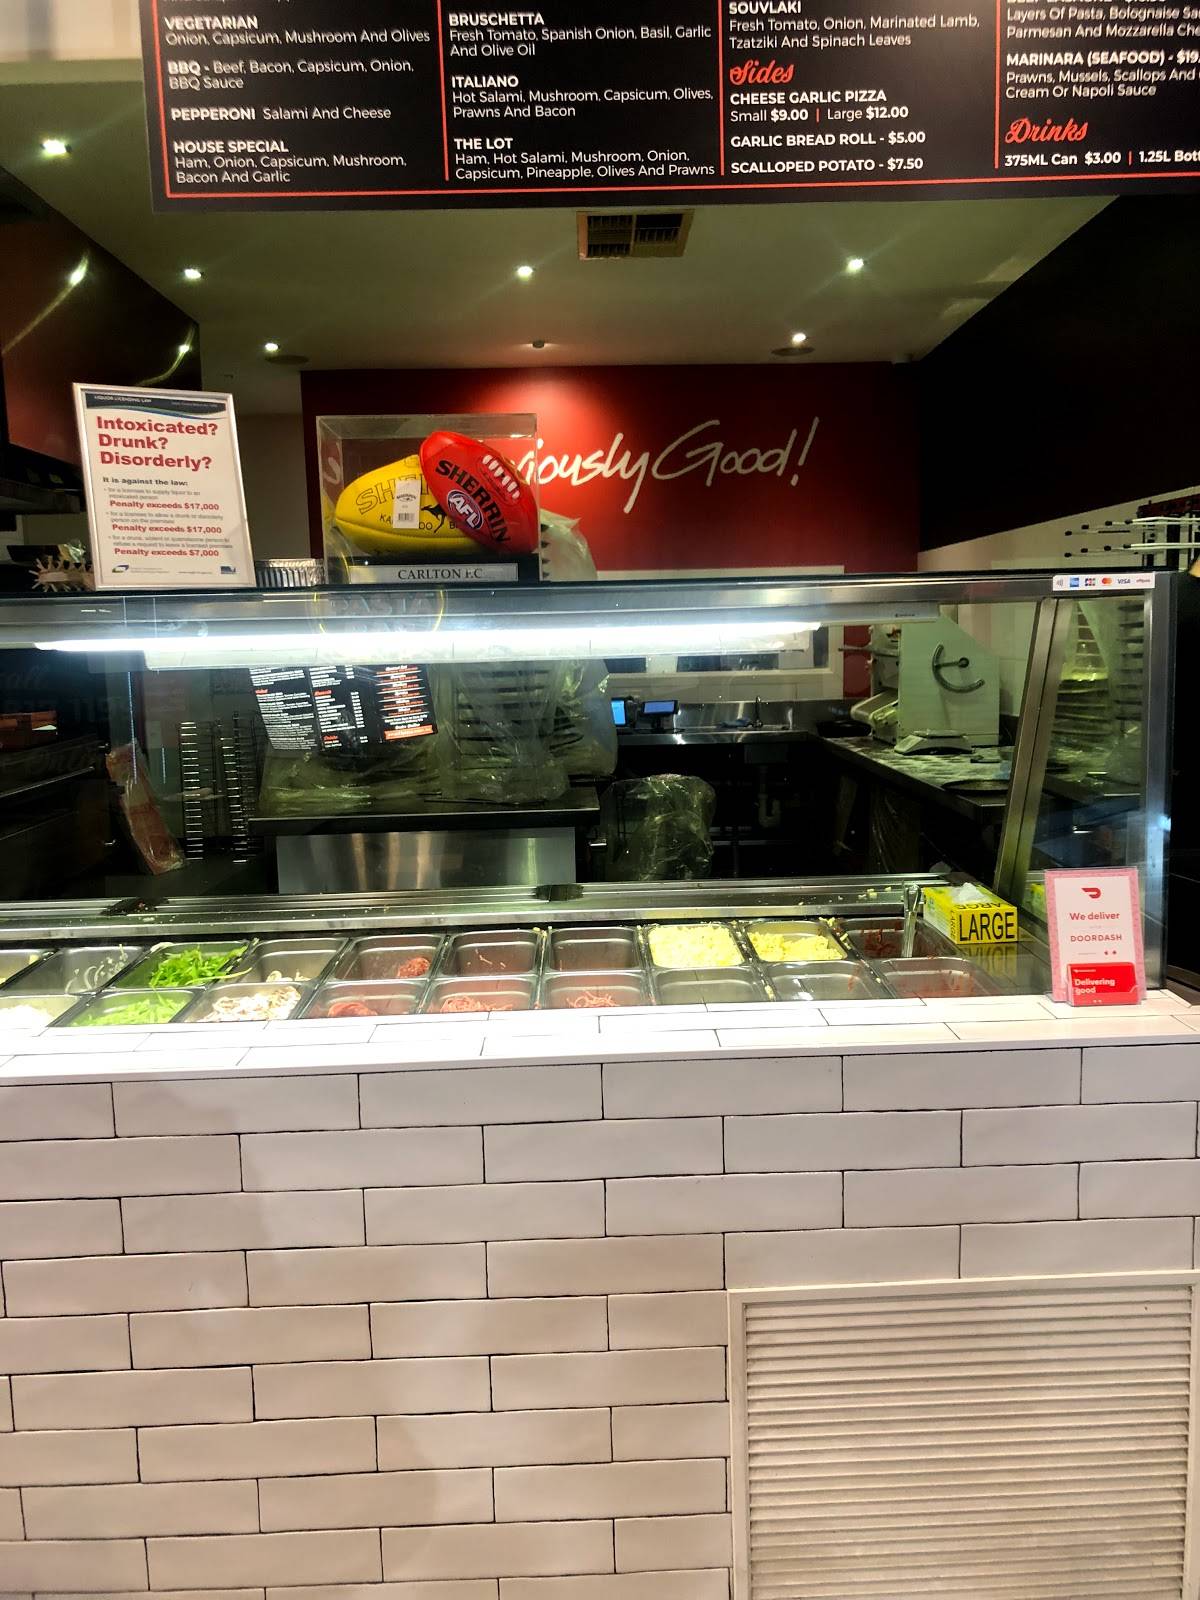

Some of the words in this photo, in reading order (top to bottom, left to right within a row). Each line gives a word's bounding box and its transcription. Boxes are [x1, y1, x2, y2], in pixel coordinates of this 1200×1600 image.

[729, 1, 801, 15] SOUVLAKI
[1008, 8, 1046, 23] Layers
[1049, 8, 1065, 19] Of
[1069, 7, 1105, 20] Pasta,
[1110, 6, 1179, 21] Bolognaise
[164, 16, 258, 30] VEGETARIAN
[449, 13, 544, 26] BRUSCHETTA
[730, 20, 764, 32] Fresh
[768, 19, 819, 31] Tomato,
[824, 18, 866, 30] Onion,
[870, 16, 936, 29] Marinated
[941, 15, 979, 28] Lamb,
[166, 31, 209, 46] Onion,
[212, 32, 282, 46] Capsicum,
[286, 30, 358, 43] Mushroom
[361, 30, 388, 42] And
[391, 29, 430, 42] Olives
[450, 30, 484, 41] Fresh
[488, 29, 538, 42] Tomato,
[541, 27, 592, 43] Spanish
[596, 27, 637, 40] Onion,
[641, 27, 672, 39] Basil,
[676, 26, 711, 38] Garlic
[1007, 26, 1071, 39] Parmesan
[1075, 25, 1101, 38] And
[1106, 24, 1174, 37] Mozzarella
[730, 36, 777, 49] Tzatziki
[781, 36, 808, 47] And
[812, 35, 865, 49] Spinach
[870, 35, 911, 46] Leaves
[450, 44, 477, 56] And
[481, 44, 514, 56] Olive
[518, 44, 535, 56] Oil
[1007, 52, 1083, 66] MARINARA
[1087, 50, 1164, 66] (SEAFOOD)
[168, 60, 201, 76] BBQ
[213, 61, 246, 74] Beef,
[250, 61, 294, 74] Bacon,
[298, 60, 367, 76] Capsicum,
[370, 60, 414, 72] Onion,
[729, 59, 794, 85] Sides
[169, 76, 200, 90] BBQ
[204, 77, 243, 89] Sauce
[452, 76, 518, 88] ITALIANO
[1007, 71, 1055, 84] Prawns,
[1059, 70, 1110, 83] Mussels,
[1114, 69, 1166, 83] Scallops
[1169, 68, 1195, 80] And
[453, 92, 476, 103] Hot
[479, 91, 526, 103] Salami,
[530, 90, 600, 102] Mushroom,
[604, 89, 670, 103] Capsicum,
[674, 88, 713, 100] Olives,
[731, 93, 785, 105] CHEESE
[789, 91, 841, 103] GARLIC
[845, 90, 886, 102] PIZZA
[1006, 86, 1049, 99] Cream
[1053, 86, 1069, 97] Or
[1073, 85, 1114, 99] Napoli
[1118, 84, 1156, 96] Sauce
[171, 108, 255, 120] PEPPERONI
[264, 108, 308, 120] Salami
[312, 108, 339, 120] And
[343, 107, 391, 119] Cheese
[453, 107, 500, 118] Prawns
[504, 106, 530, 117] And
[535, 106, 575, 117] Bacon
[731, 110, 767, 122] Small
[771, 109, 808, 122] $9.00
[828, 108, 862, 122] Large
[866, 106, 909, 119] $12.00
[1005, 117, 1088, 143] Drinks
[174, 140, 224, 154] HOUSE
[228, 140, 288, 152] SPECIAL
[455, 138, 482, 150] THE
[486, 138, 513, 149] LOT
[731, 135, 782, 148] GARLIC
[787, 134, 835, 146] BREAD
[840, 133, 876, 145] ROLL
[888, 131, 925, 144] $5.00
[176, 156, 210, 169] Ham,
[214, 156, 257, 169] Onion,
[261, 155, 329, 170] Capsicum,
[333, 154, 406, 167] Mushroom,
[456, 154, 490, 165] Ham,
[493, 153, 517, 164] Hot
[521, 152, 567, 164] Salami,
[572, 151, 644, 163] Mushroom,
[647, 150, 689, 162] Onion,
[731, 161, 815, 173] SCALLOPED
[819, 159, 875, 172] POTATO
[888, 157, 923, 171] $7.50
[1005, 154, 1048, 166] 375ML
[1052, 153, 1077, 165] Can
[1085, 151, 1121, 166] $3.00
[1140, 150, 1171, 162] 1.25L
[177, 171, 218, 183] Bacon
[222, 170, 249, 183] And
[253, 170, 290, 182] Garlic
[456, 168, 523, 181] Capsicum,
[527, 167, 594, 180] Pineapple,
[598, 166, 635, 177] Olives
[638, 165, 664, 176] And
[669, 164, 714, 175] Prawns
[96, 415, 218, 436] Intoxicated?
[99, 433, 168, 449] Drunk?
[652, 416, 819, 486] Good!
[100, 451, 212, 472] Disorderly?
[122, 477, 153, 486] against
[110, 500, 144, 509] Penalty
[184, 502, 219, 511] $17,000
[435, 460, 511, 544] SHERRIN
[449, 496, 480, 529] AFL
[112, 524, 146, 533] Penalty
[187, 526, 222, 534] $17,000
[114, 548, 148, 557] Penalty
[151, 549, 187, 557] exceeds
[189, 549, 219, 557] $7,000
[398, 569, 461, 580] CARLTON
[1088, 912, 1120, 920] deliver
[959, 912, 1014, 941] LARGE
[1071, 934, 1122, 942] DOORDASH
[1075, 978, 1115, 986] Delivering
[1075, 987, 1096, 995] good
